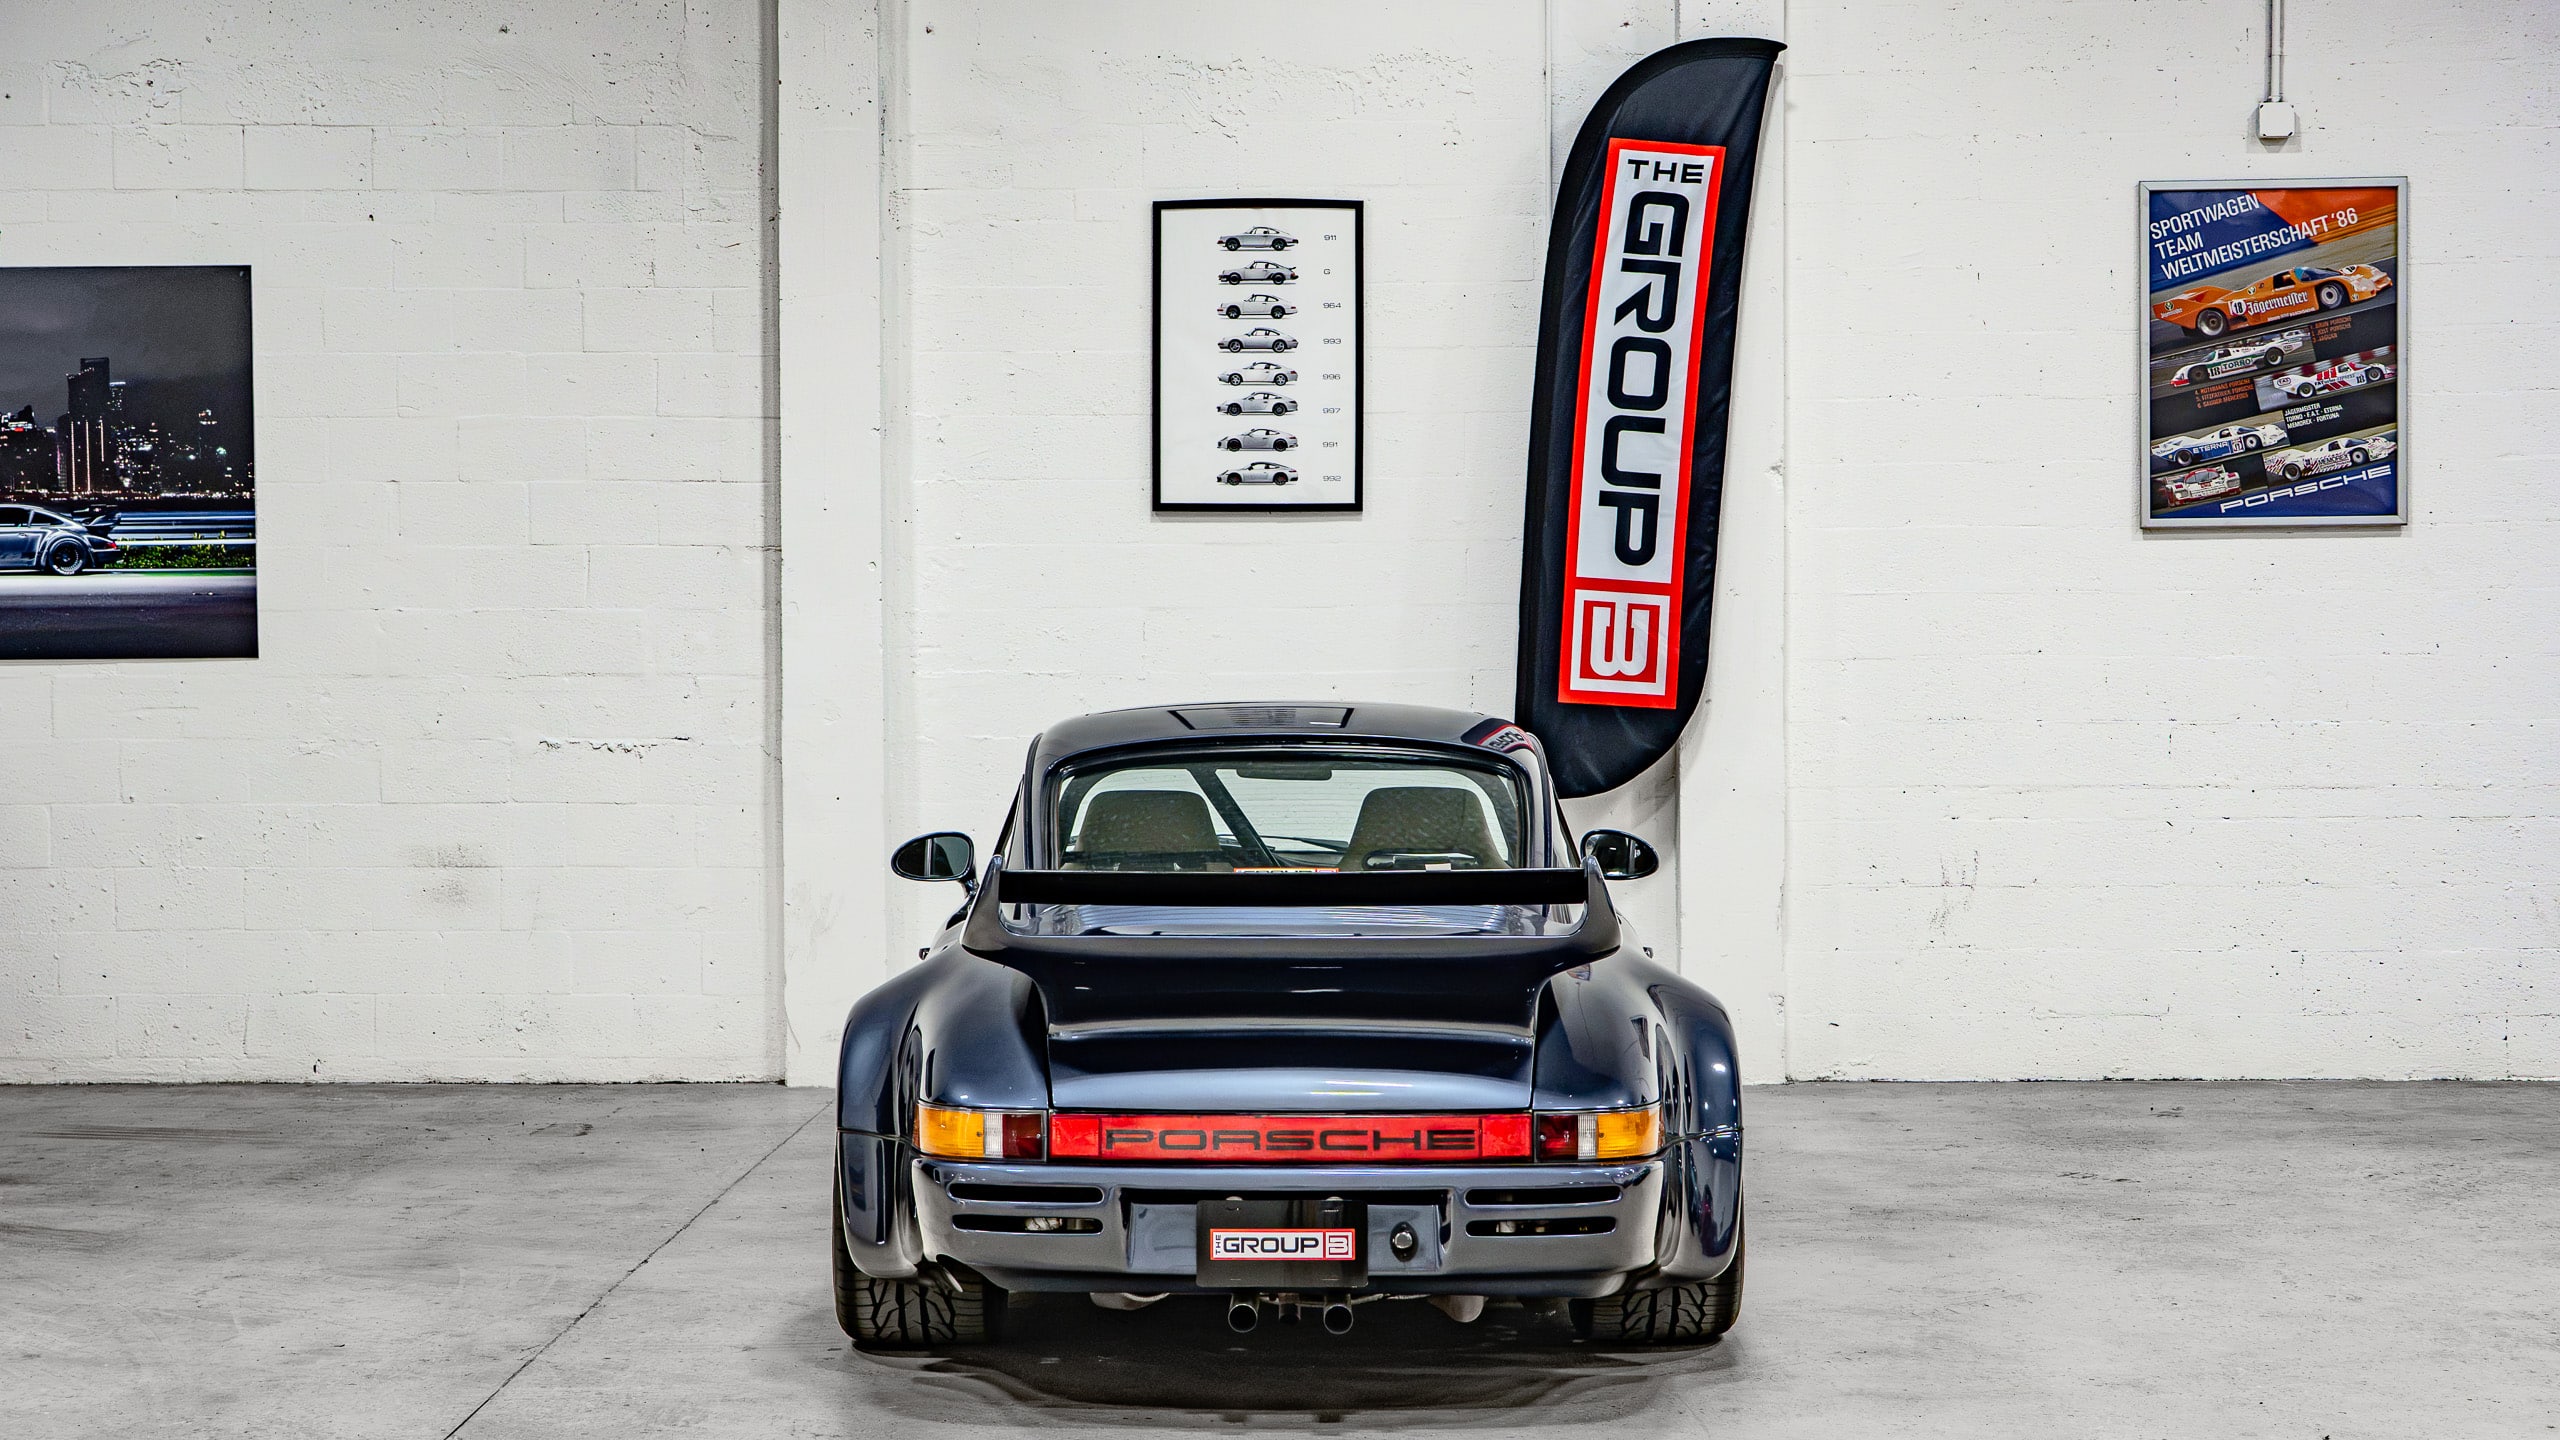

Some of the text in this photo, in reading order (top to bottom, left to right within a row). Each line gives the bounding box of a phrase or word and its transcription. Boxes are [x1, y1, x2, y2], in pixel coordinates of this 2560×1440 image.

[1628, 159, 1705, 185] THE
[2150, 192, 2260, 240] SPORTWAGEN
[2155, 232, 2204, 260] TEAM
[2160, 214, 2329, 280] WELTMEISTERSCHAFT
[1599, 190, 1690, 566] GROUP
[2193, 441, 2228, 454] ETERNA
[2220, 465, 2392, 513] PORSCHE
[1105, 1129, 1475, 1151] PORSCHE
[1223, 1237, 1319, 1254] GROUP
